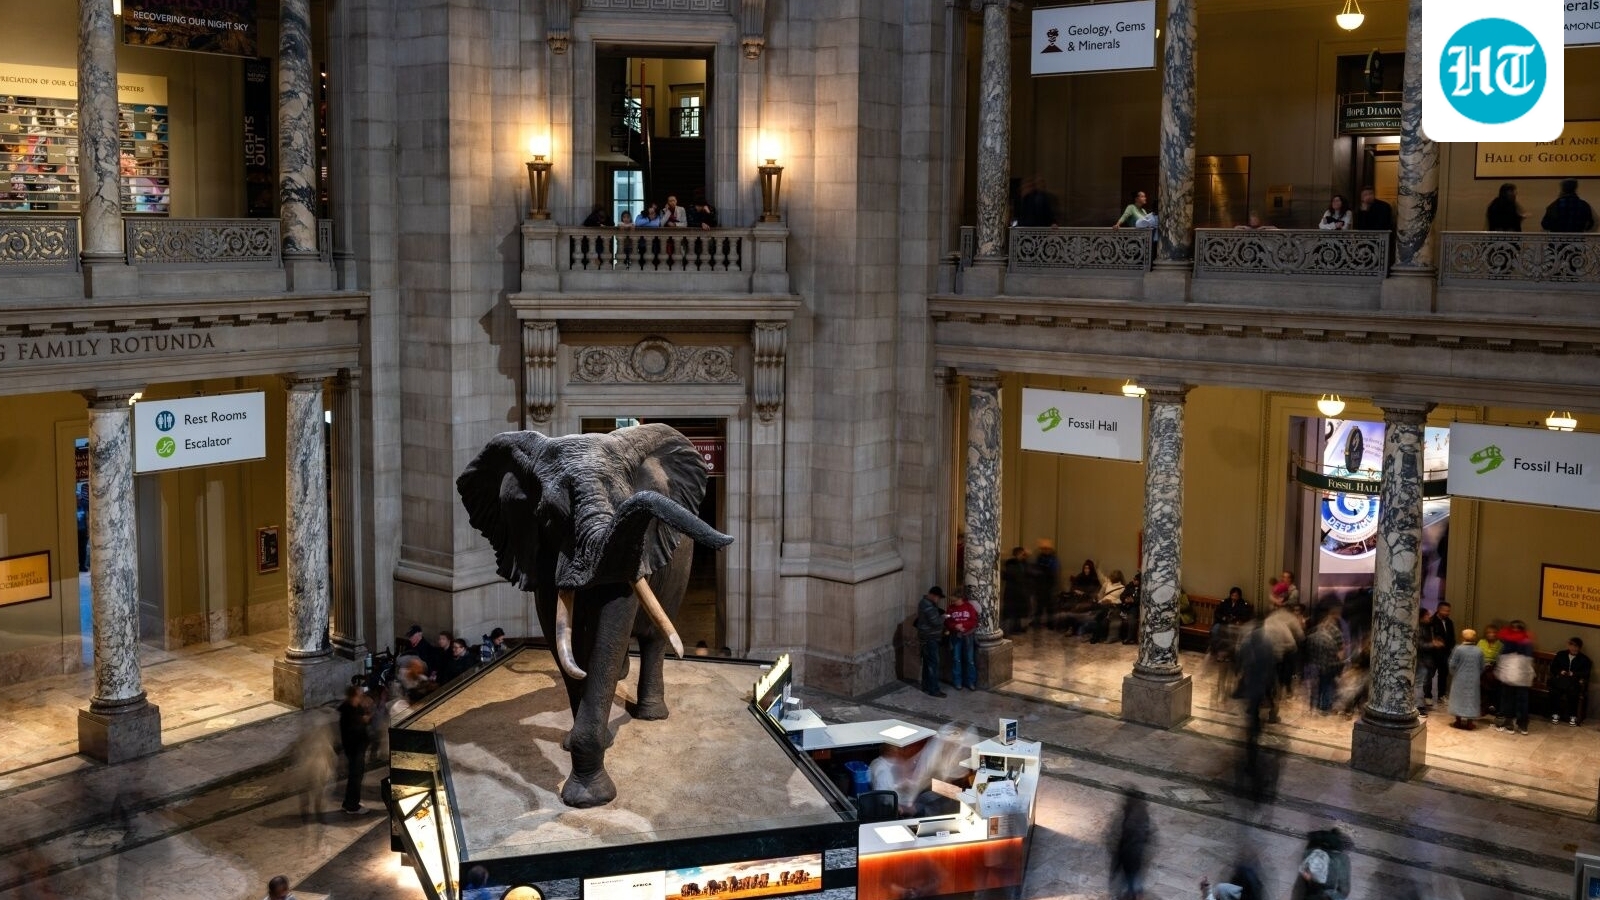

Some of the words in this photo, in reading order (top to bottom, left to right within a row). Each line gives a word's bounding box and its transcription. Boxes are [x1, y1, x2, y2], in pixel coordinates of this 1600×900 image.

[1564, 0, 1599, 11] erals
[133, 10, 187, 24] RECOVERING
[188, 17, 206, 27] OUR
[207, 19, 232, 30] NIGHT
[233, 22, 249, 32] SKY
[1068, 24, 1112, 37] Geology,
[1115, 21, 1146, 33] Gems
[1067, 41, 1075, 52] &
[1078, 38, 1121, 51] Minerals
[51, 79, 67, 87] OUR
[117, 85, 145, 93] PORTERS
[245, 116, 255, 166] LIGHTS
[255, 135, 266, 166] OUT
[1485, 153, 1513, 163] HALL
[1519, 153, 1534, 163] OF
[18, 339, 100, 360] FAMILY
[110, 333, 216, 354] ROTUNDA
[184, 414, 208, 425] Rest
[211, 411, 247, 422] Rooms
[1068, 417, 1095, 429] Fossil
[1098, 420, 1118, 431] Hall
[185, 436, 232, 449] Escalator
[1513, 457, 1551, 472] Fossil
[1556, 461, 1583, 475] Hall
[1328, 479, 1353, 490] FOSSIL
[1356, 483, 1380, 493] HALL
[1327, 516, 1352, 533] DEEP
[1553, 583, 1575, 591] DAVID
[1558, 599, 1578, 607] DEEP
[1580, 602, 1600, 610] TIME
